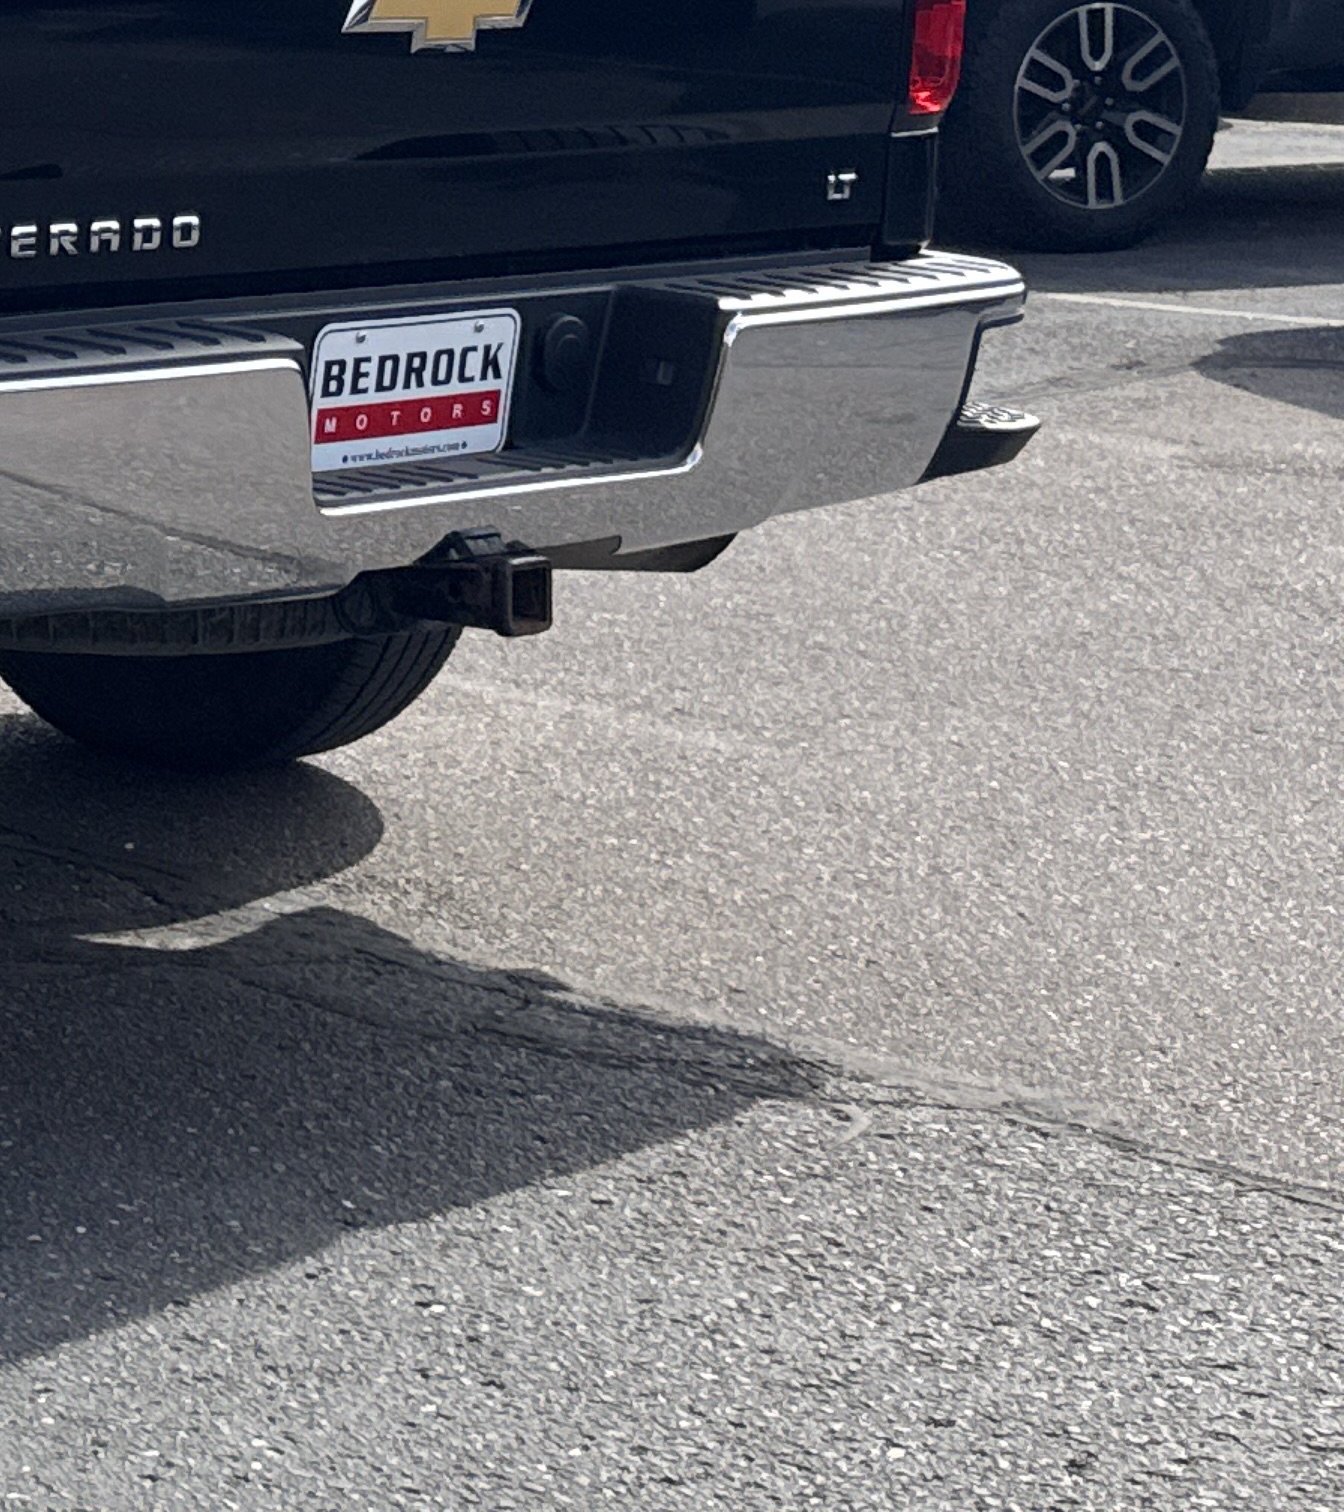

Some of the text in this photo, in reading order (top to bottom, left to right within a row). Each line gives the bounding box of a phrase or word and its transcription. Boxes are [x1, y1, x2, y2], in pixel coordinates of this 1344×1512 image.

[827, 172, 858, 200] LT
[320, 342, 504, 399] BEDROCK
[324, 400, 492, 433] MOTORS
